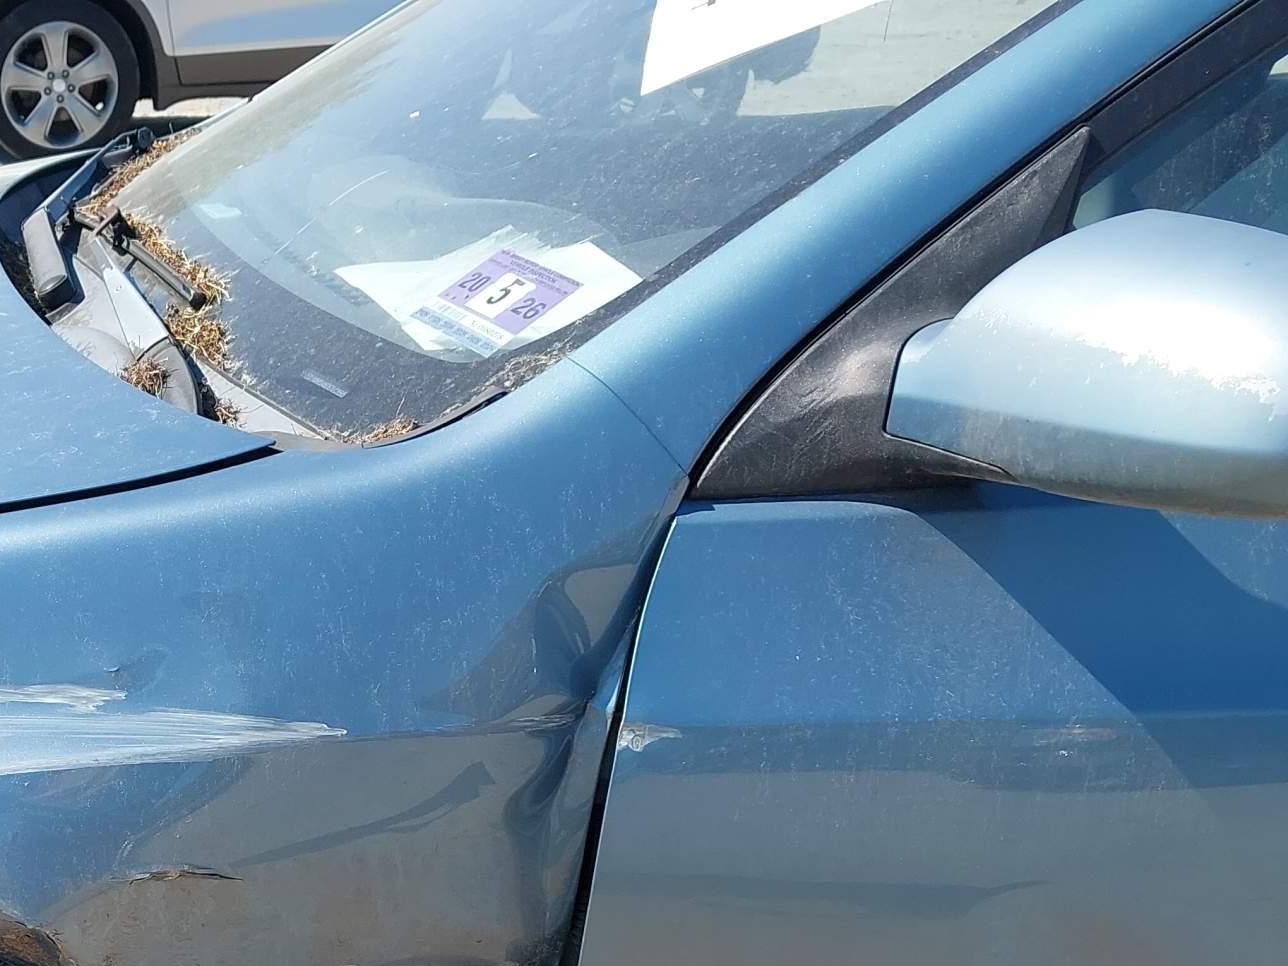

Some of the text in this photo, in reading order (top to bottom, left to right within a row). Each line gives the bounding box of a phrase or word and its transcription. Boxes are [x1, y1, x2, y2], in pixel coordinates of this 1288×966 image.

[457, 271, 492, 293] 20
[486, 278, 526, 305] 5
[509, 297, 548, 320] 26
